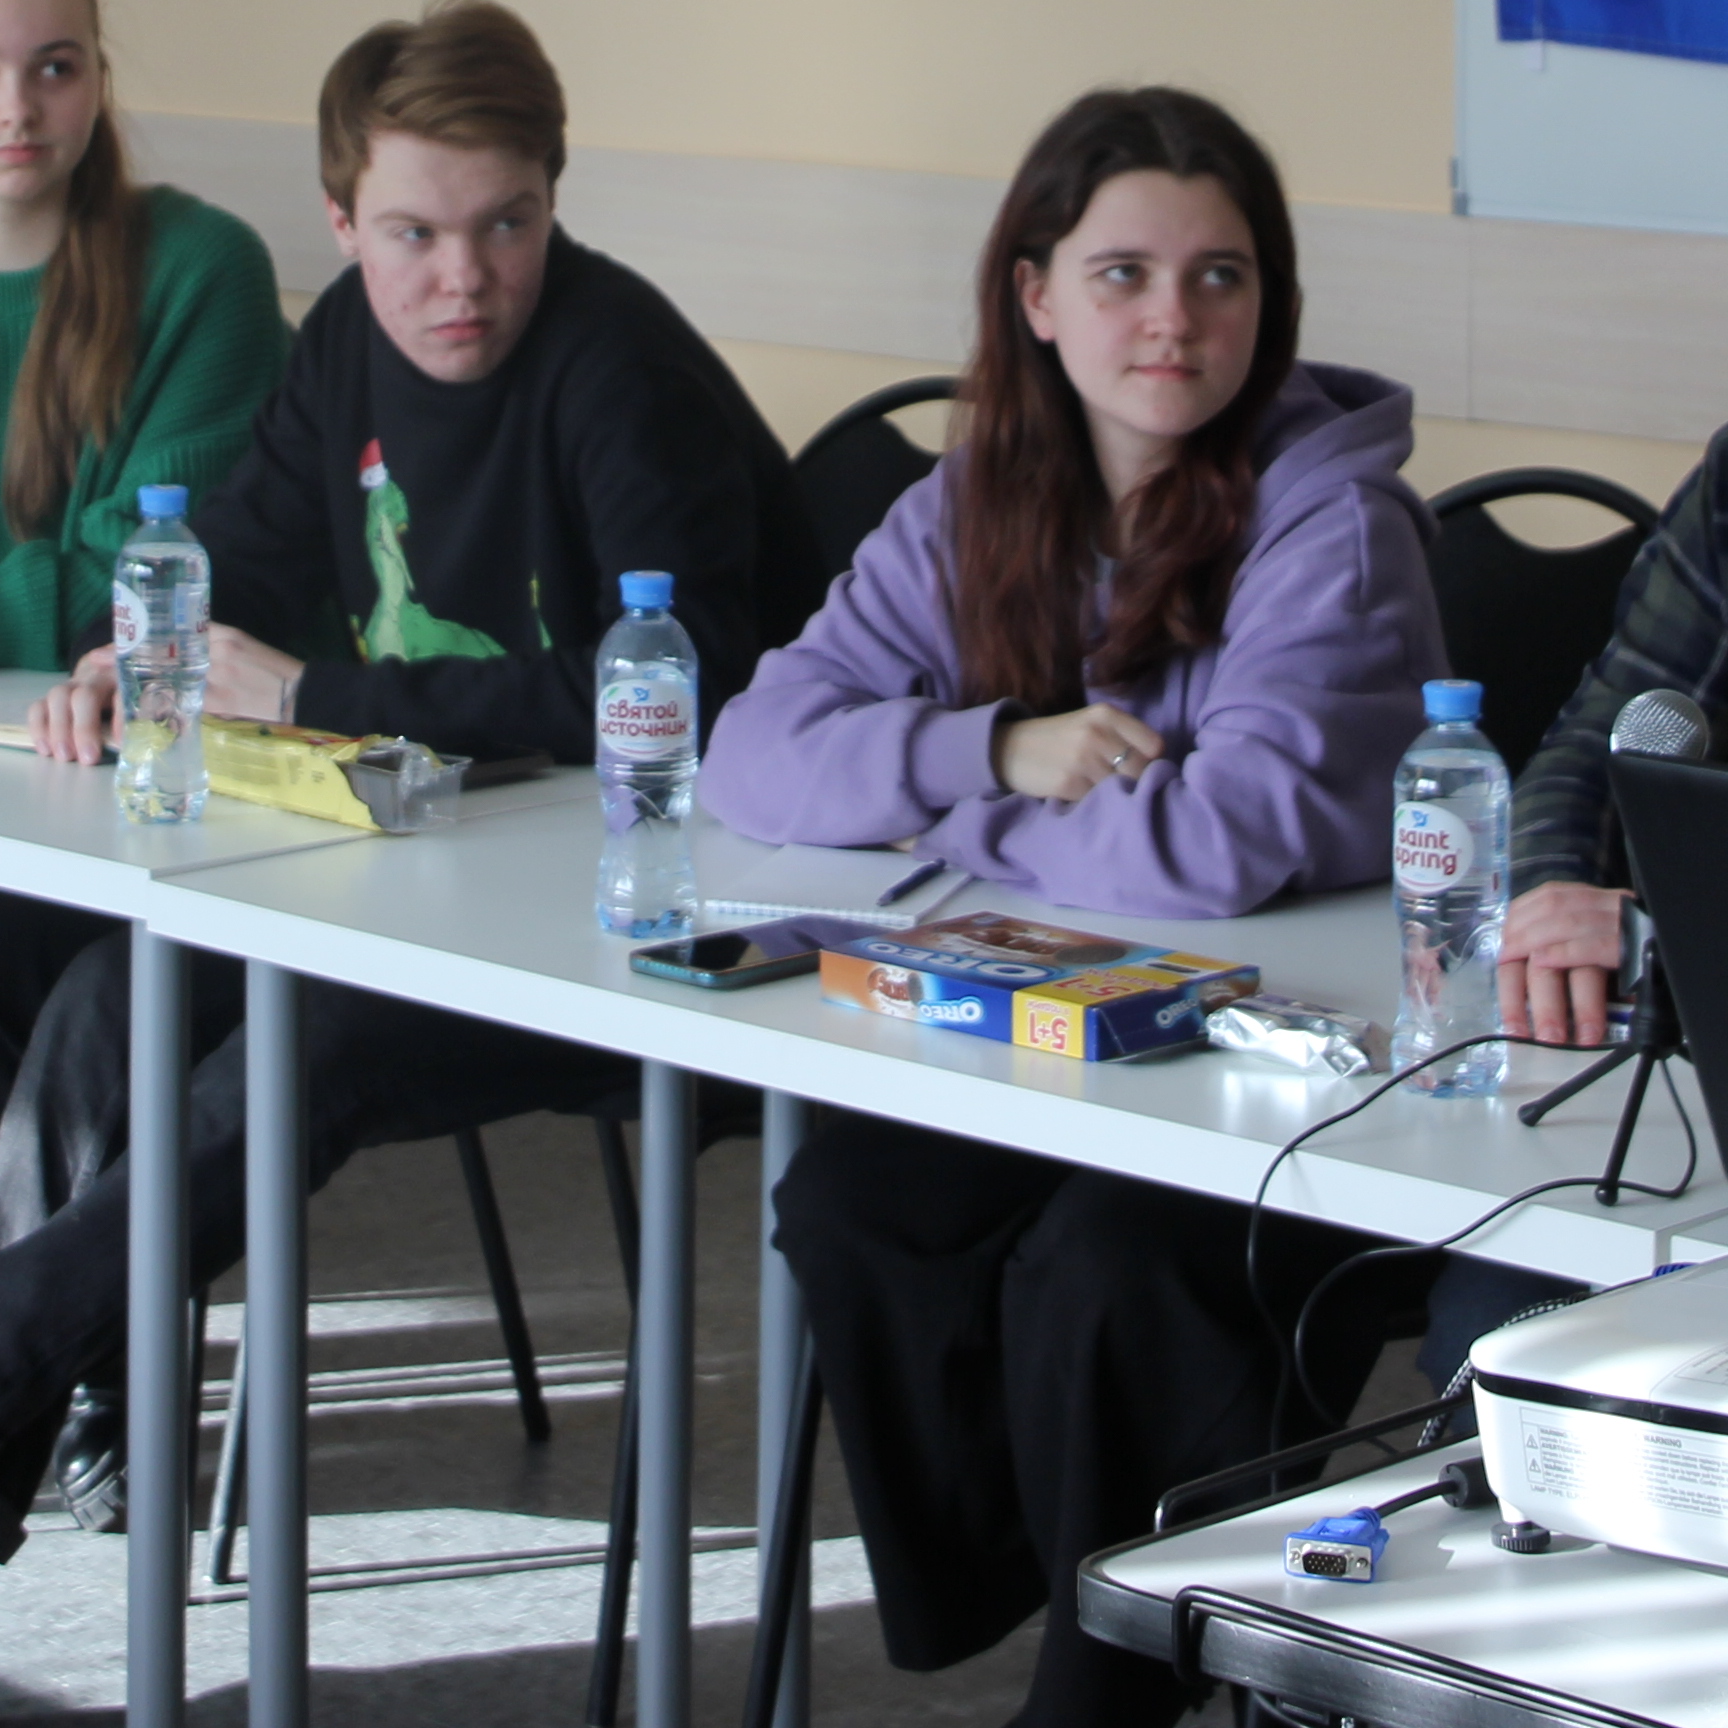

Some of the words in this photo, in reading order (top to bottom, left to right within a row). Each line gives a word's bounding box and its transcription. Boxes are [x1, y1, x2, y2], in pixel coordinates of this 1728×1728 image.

[1398, 827, 1450, 850] saint
[1395, 845, 1458, 876] spring
[867, 942, 1048, 978] OREO
[920, 1001, 982, 1021] OREO
[1029, 1011, 1068, 1050] 5+1
